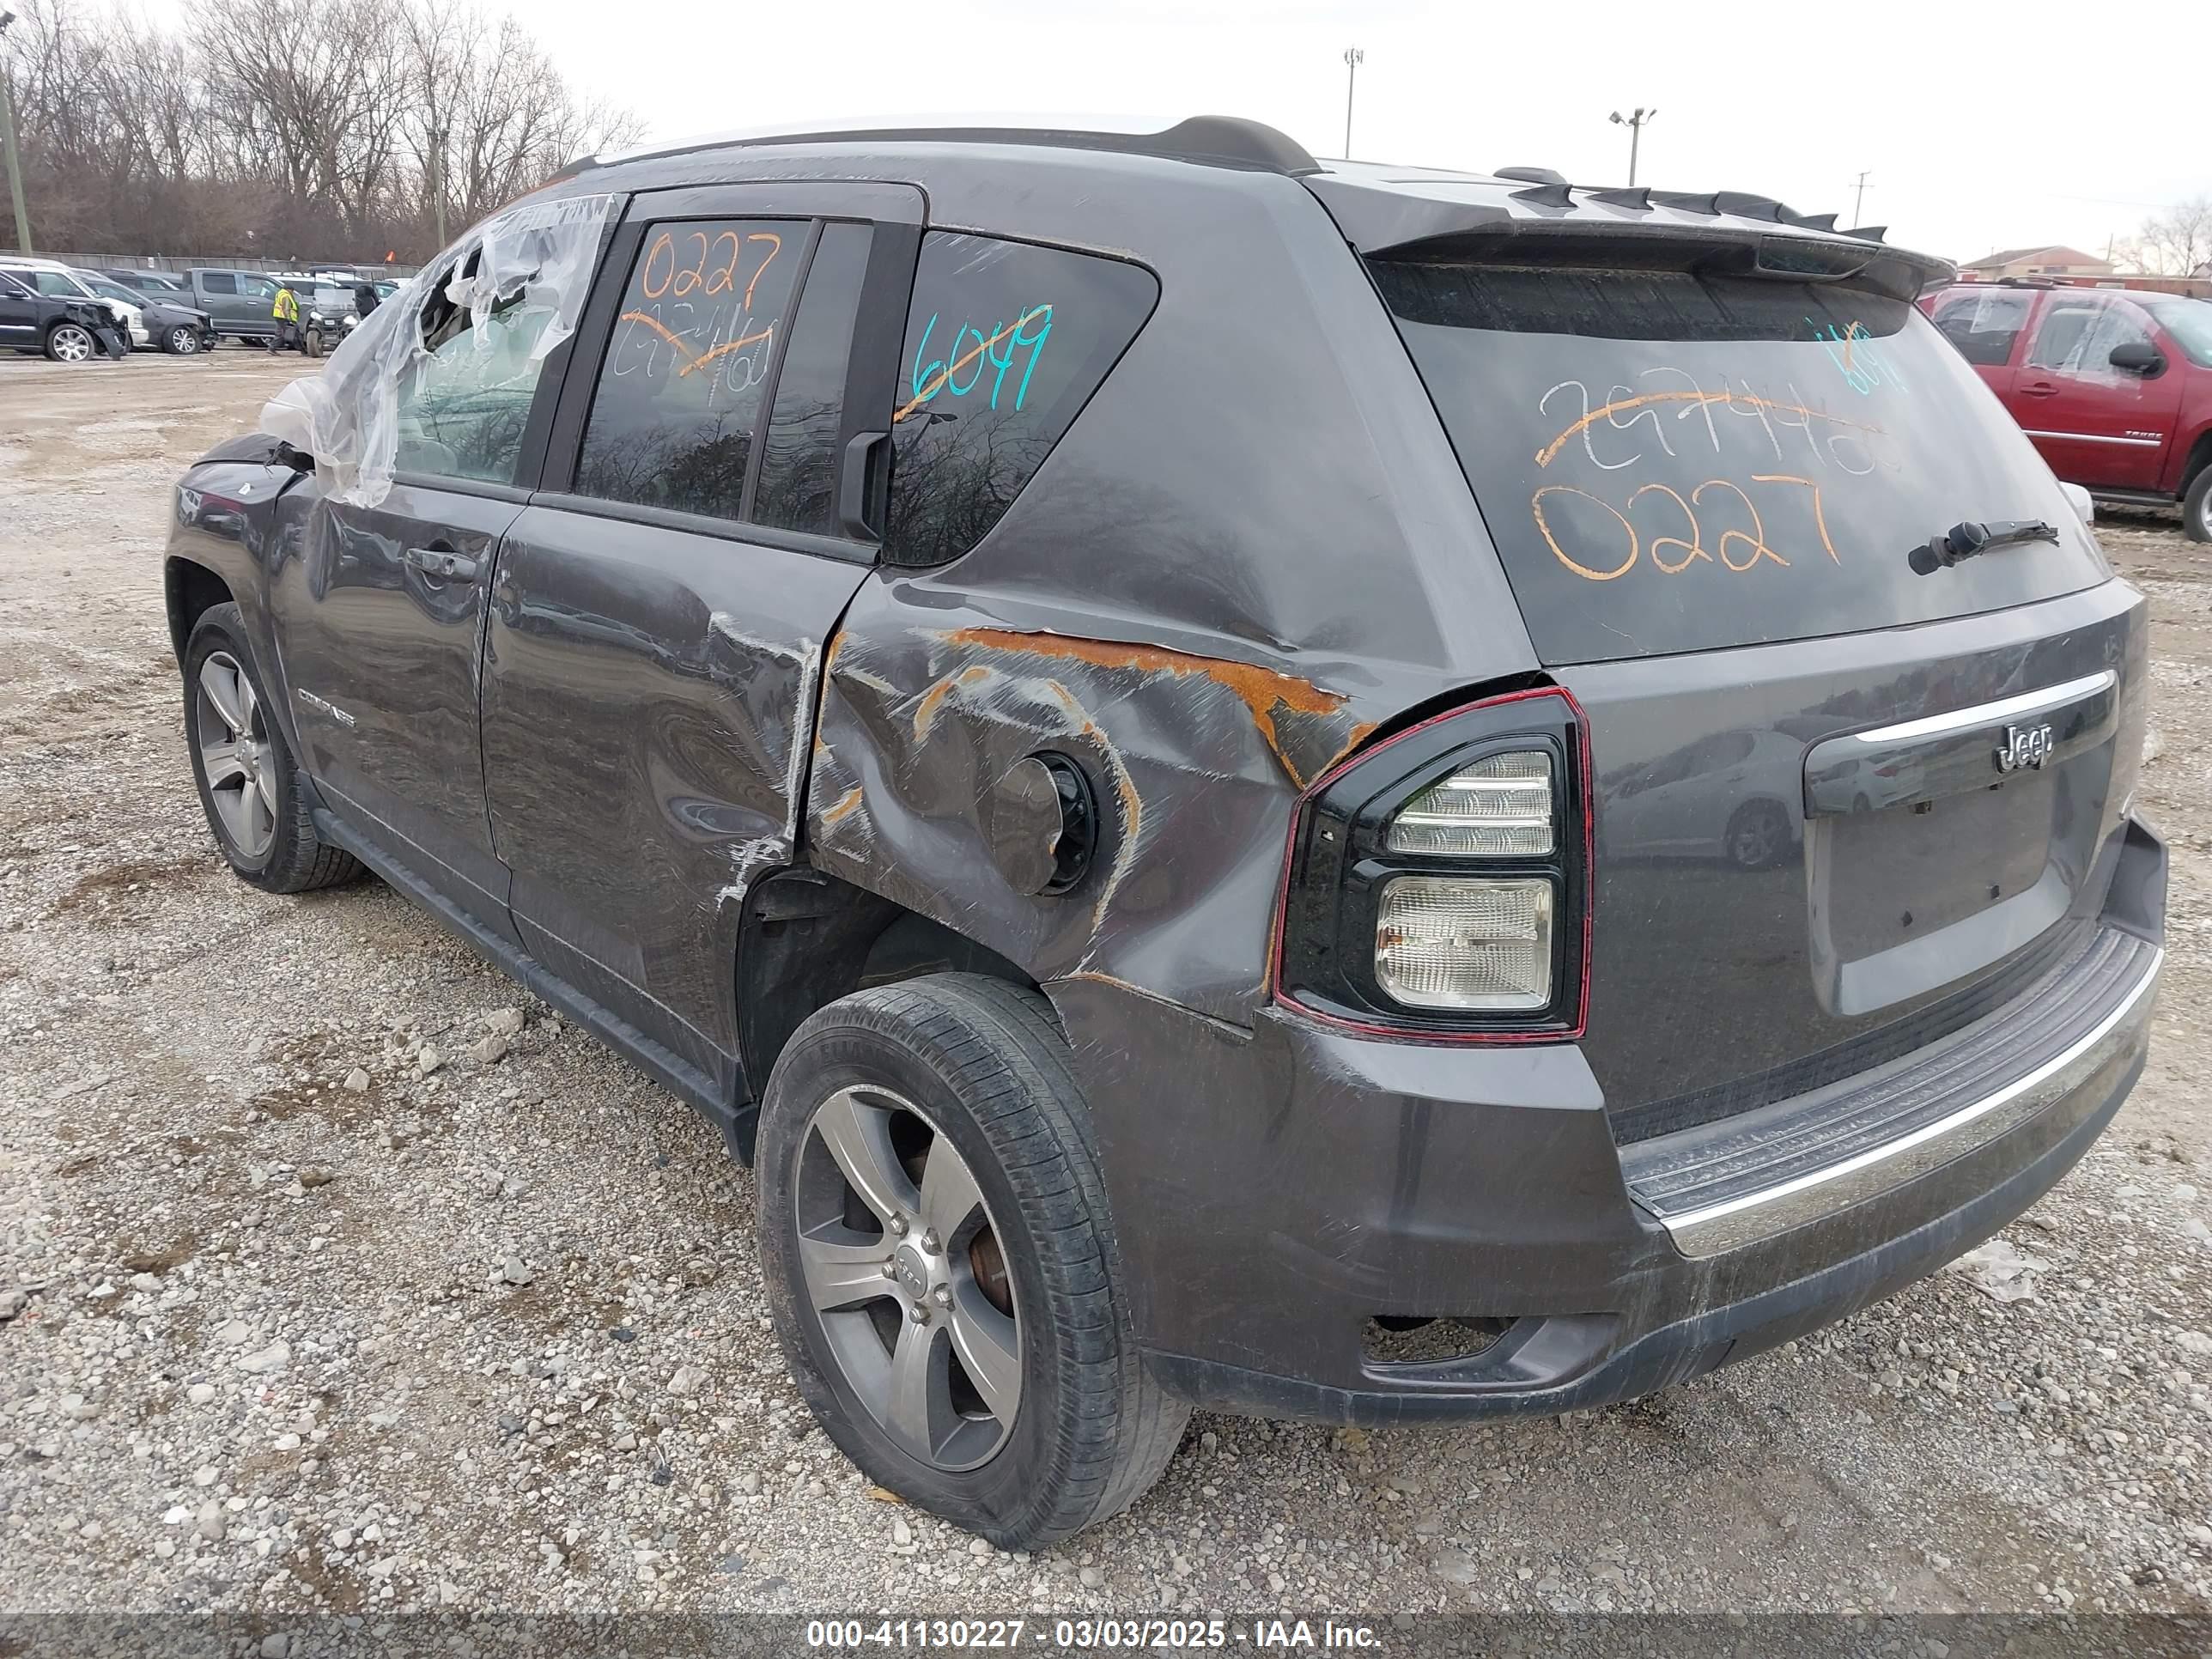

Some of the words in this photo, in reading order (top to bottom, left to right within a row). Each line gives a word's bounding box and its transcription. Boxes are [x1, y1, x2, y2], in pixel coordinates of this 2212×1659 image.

[641, 231, 782, 313] 0227
[912, 303, 1054, 410] 6049
[1532, 475, 1841, 581] 0227
[1997, 724, 2055, 772] Jeep
